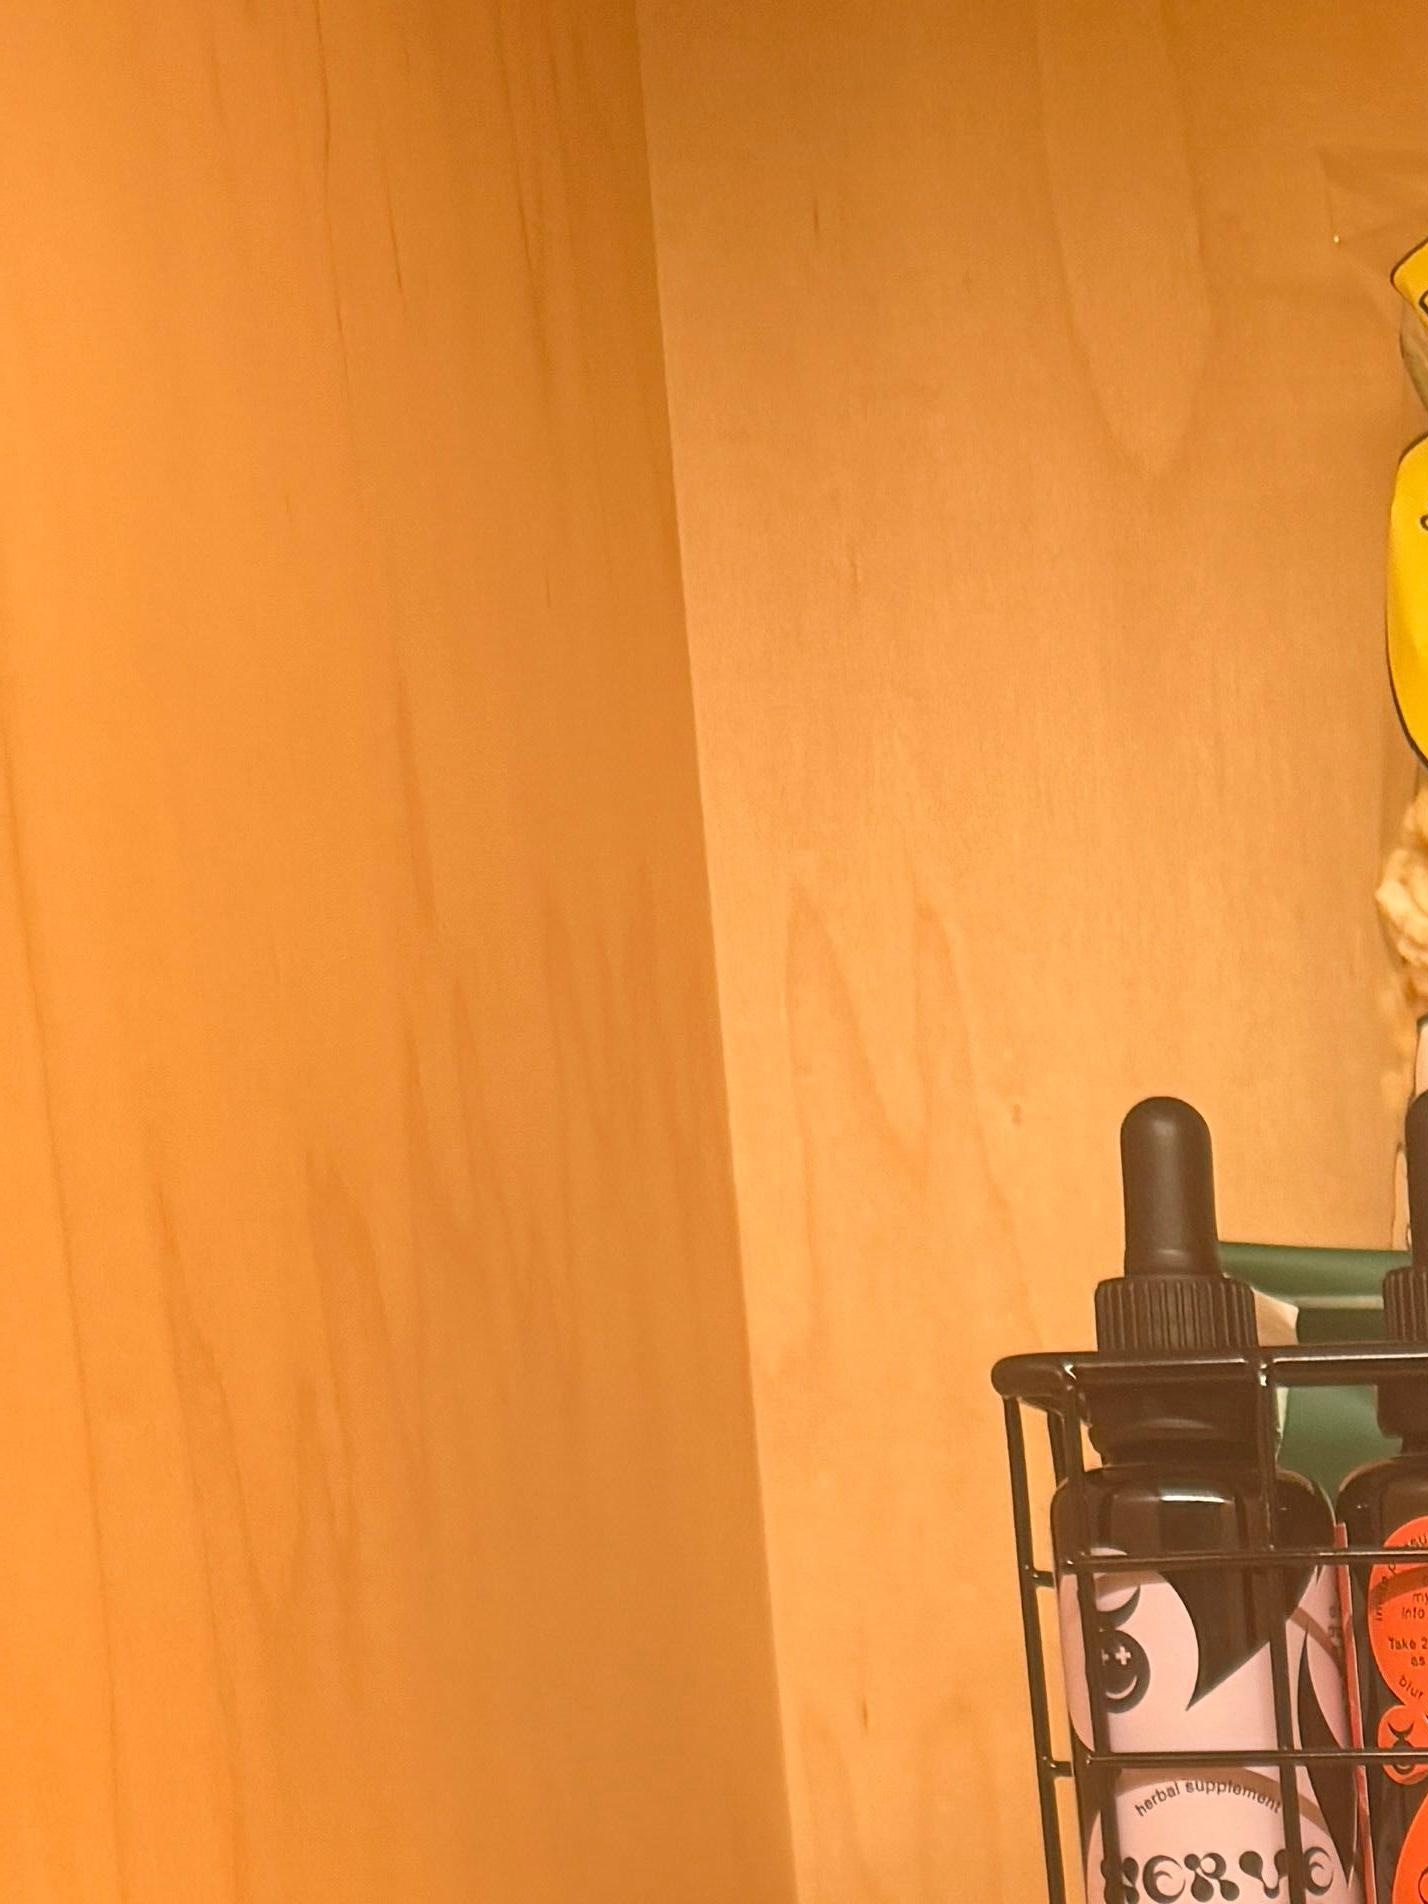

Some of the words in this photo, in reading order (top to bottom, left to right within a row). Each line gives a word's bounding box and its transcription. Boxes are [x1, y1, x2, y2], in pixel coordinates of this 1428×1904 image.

[1389, 1637, 1417, 1650] Take
[1420, 1637, 1428, 1650] 2
[1410, 1656, 1424, 1667] as
[1399, 1676, 1424, 1700] blur
[1134, 1782, 1181, 1817] herbal
[1185, 1778, 1282, 1816] supplement
